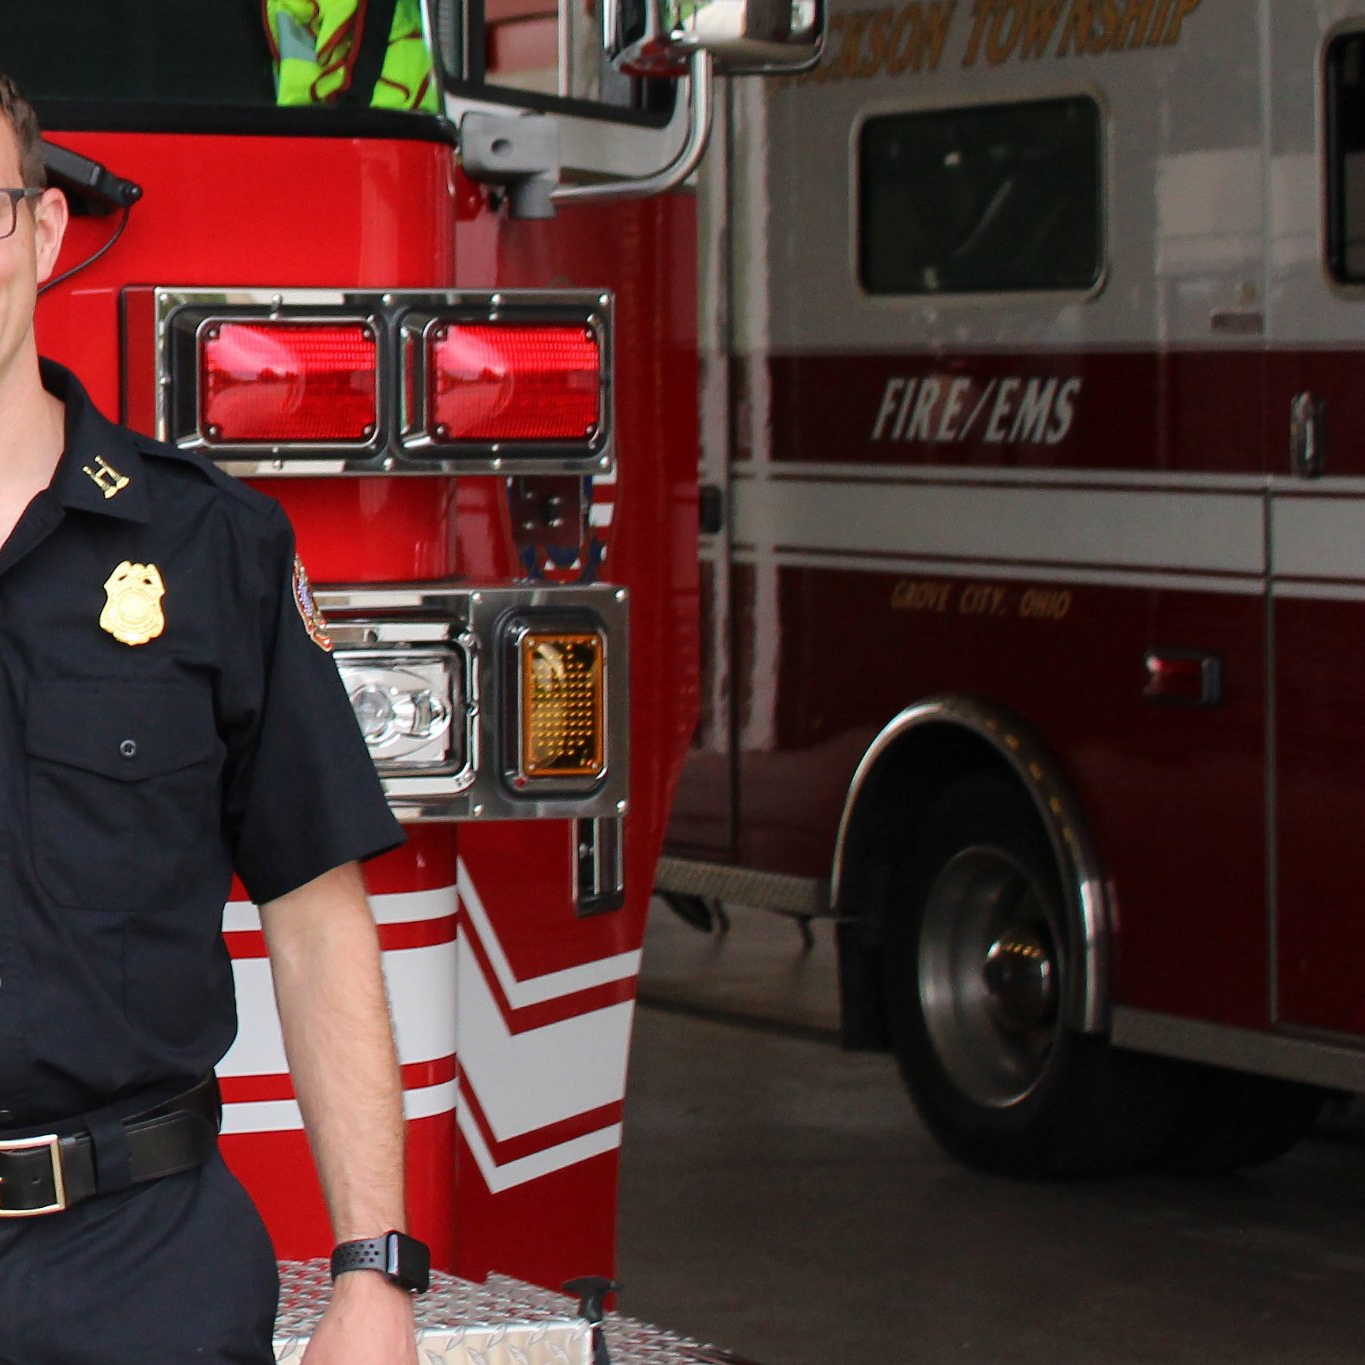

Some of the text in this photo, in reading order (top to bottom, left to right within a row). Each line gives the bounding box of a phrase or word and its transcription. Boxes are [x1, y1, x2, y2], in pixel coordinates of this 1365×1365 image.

[773, 0, 1202, 86] CKSON TOWNSHIP
[872, 376, 1082, 444] FIRE/EMS
[890, 579, 952, 613] GROVE
[1019, 588, 1073, 620] OHIO
